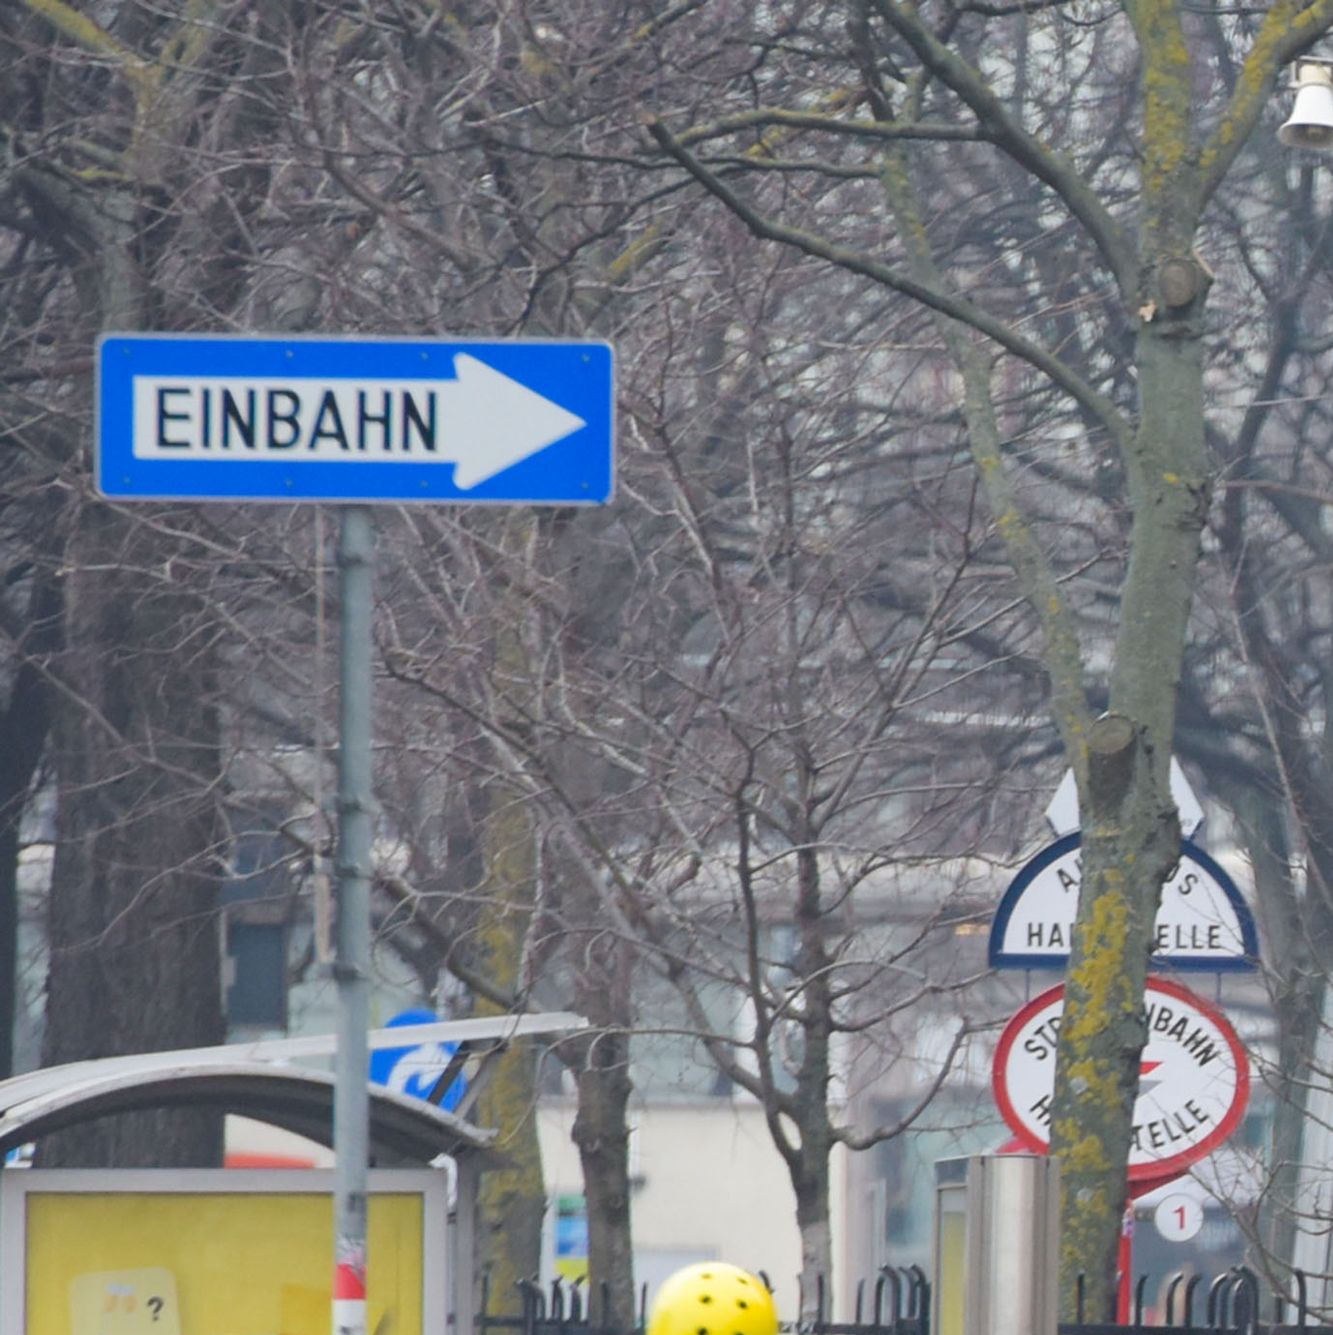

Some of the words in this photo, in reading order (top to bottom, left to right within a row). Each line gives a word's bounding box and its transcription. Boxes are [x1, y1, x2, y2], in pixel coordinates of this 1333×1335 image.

[156, 386, 437, 452] EINBAHN
[1027, 922, 1221, 950] HAELLE
[1030, 1094, 1210, 1152] HTELLE
[1173, 1205, 1186, 1230] 1
